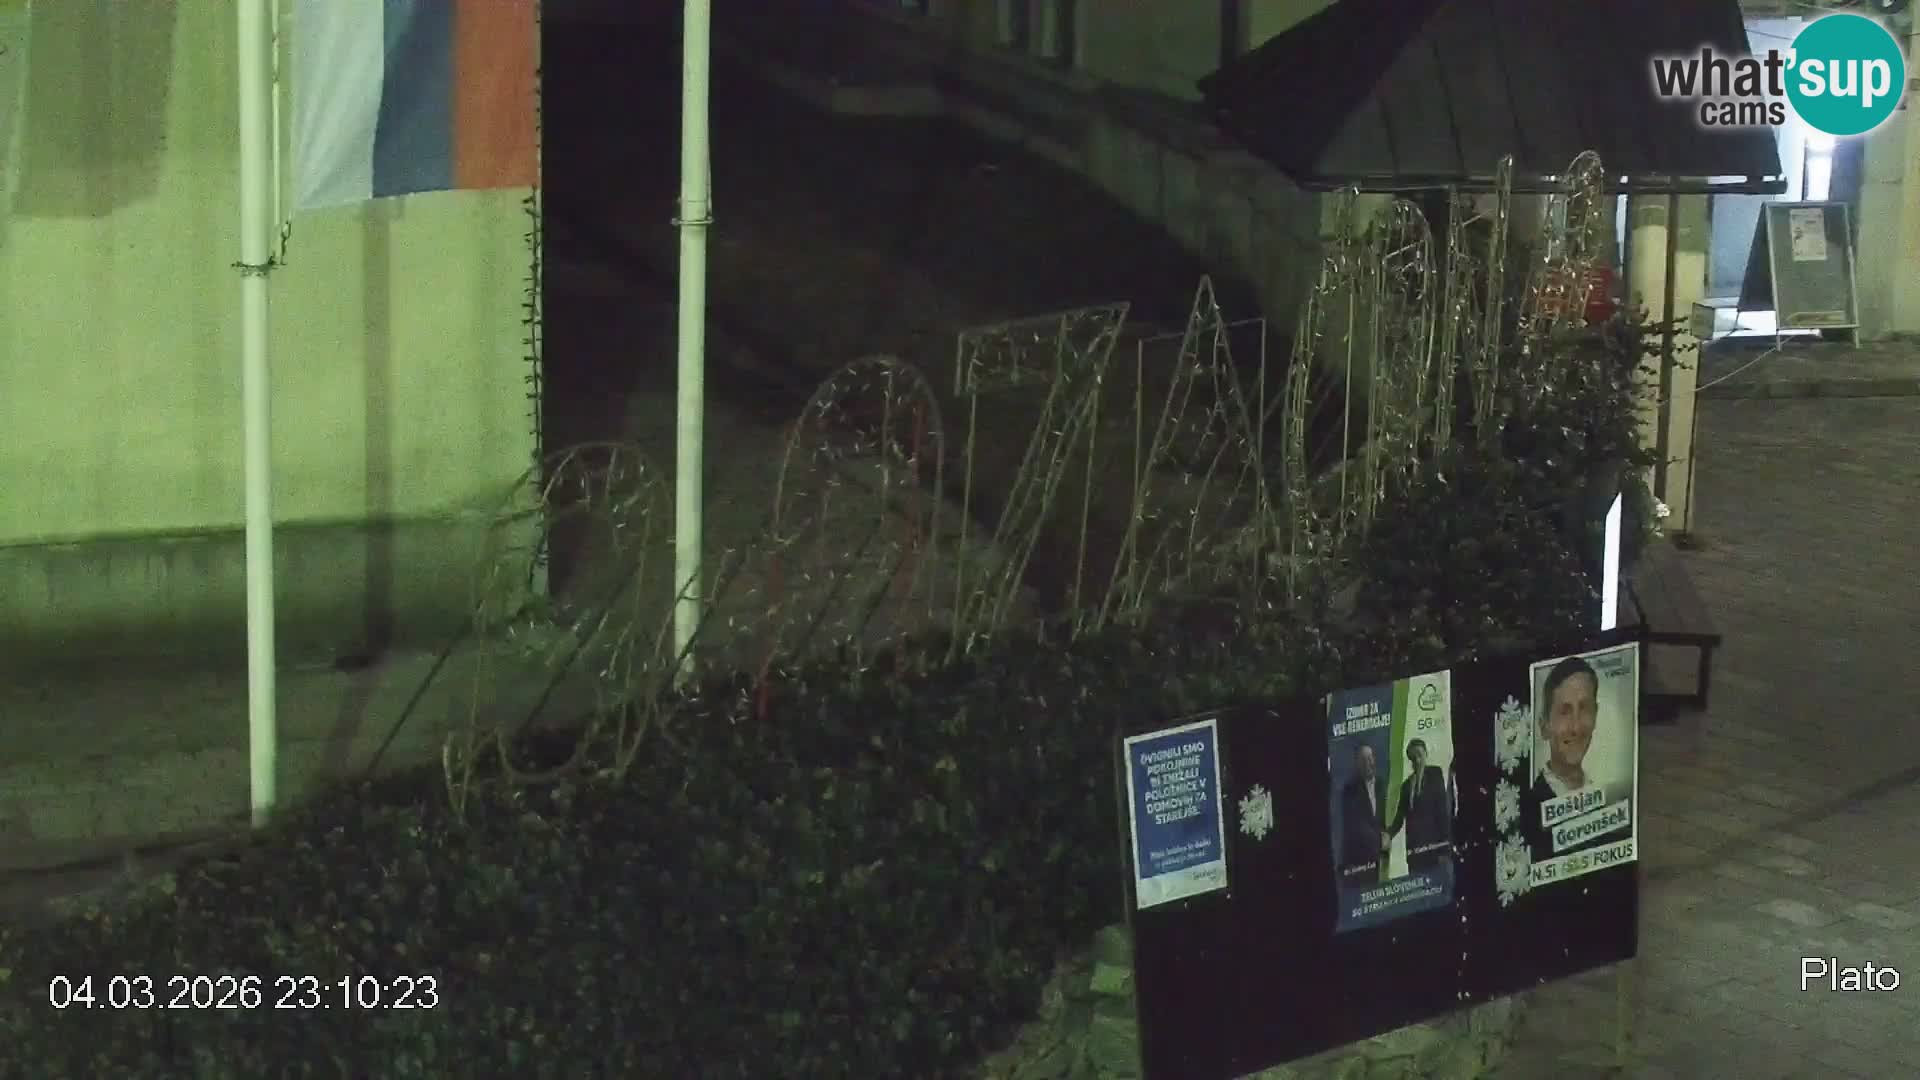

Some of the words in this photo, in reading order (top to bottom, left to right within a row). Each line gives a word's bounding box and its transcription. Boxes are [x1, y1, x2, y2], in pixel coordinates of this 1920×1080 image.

[1183, 742, 1205, 754] SMO
[1199, 777, 1207, 788] V
[1593, 843, 1633, 866] FOKUS
